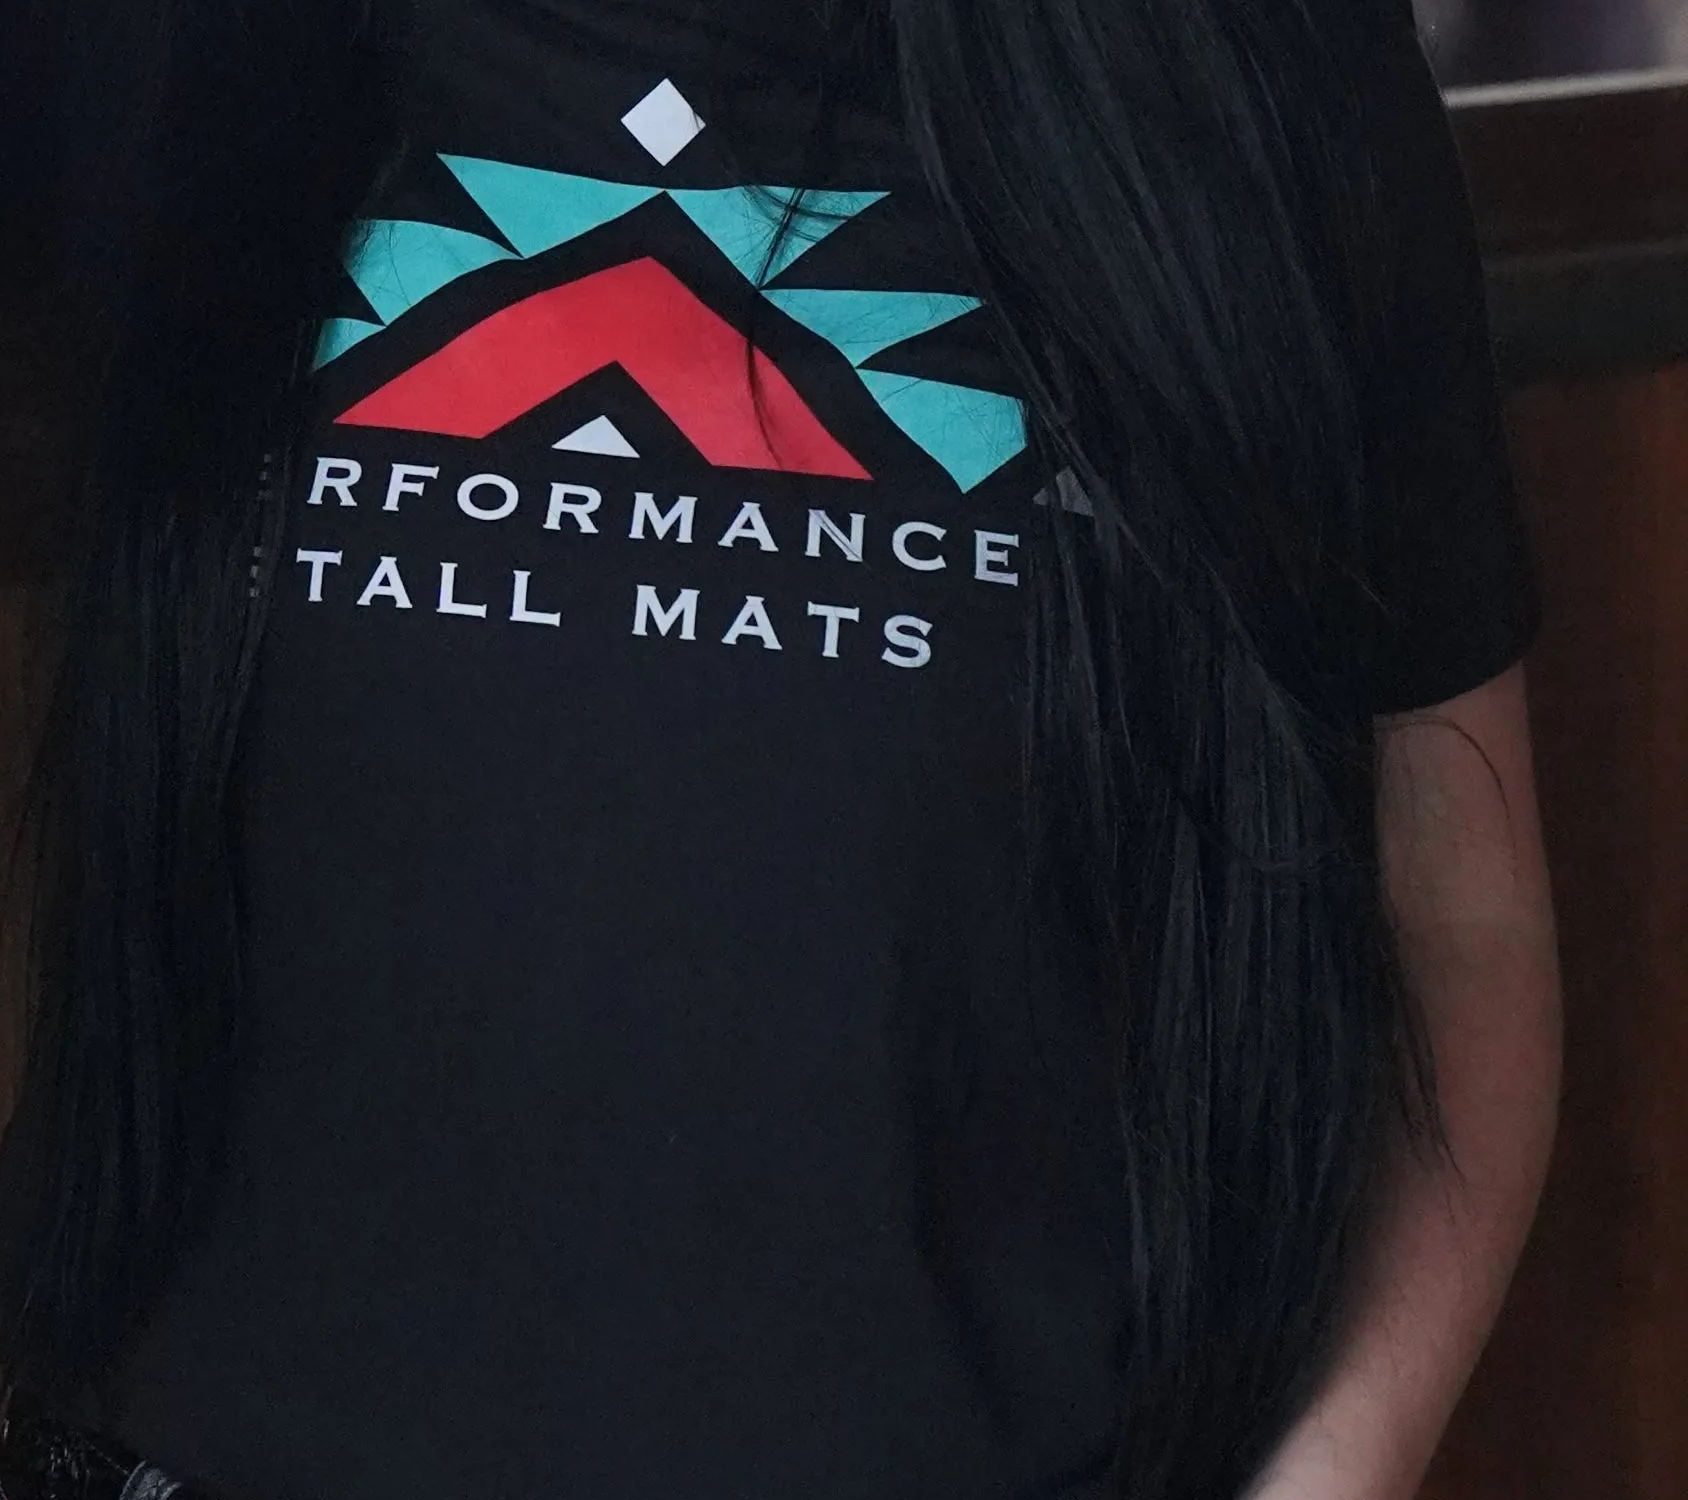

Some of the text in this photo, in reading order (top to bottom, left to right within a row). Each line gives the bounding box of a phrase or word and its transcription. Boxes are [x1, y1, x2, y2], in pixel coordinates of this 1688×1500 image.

[258, 453, 1020, 587] RFORMANCE
[250, 546, 933, 668] TALL MATS
